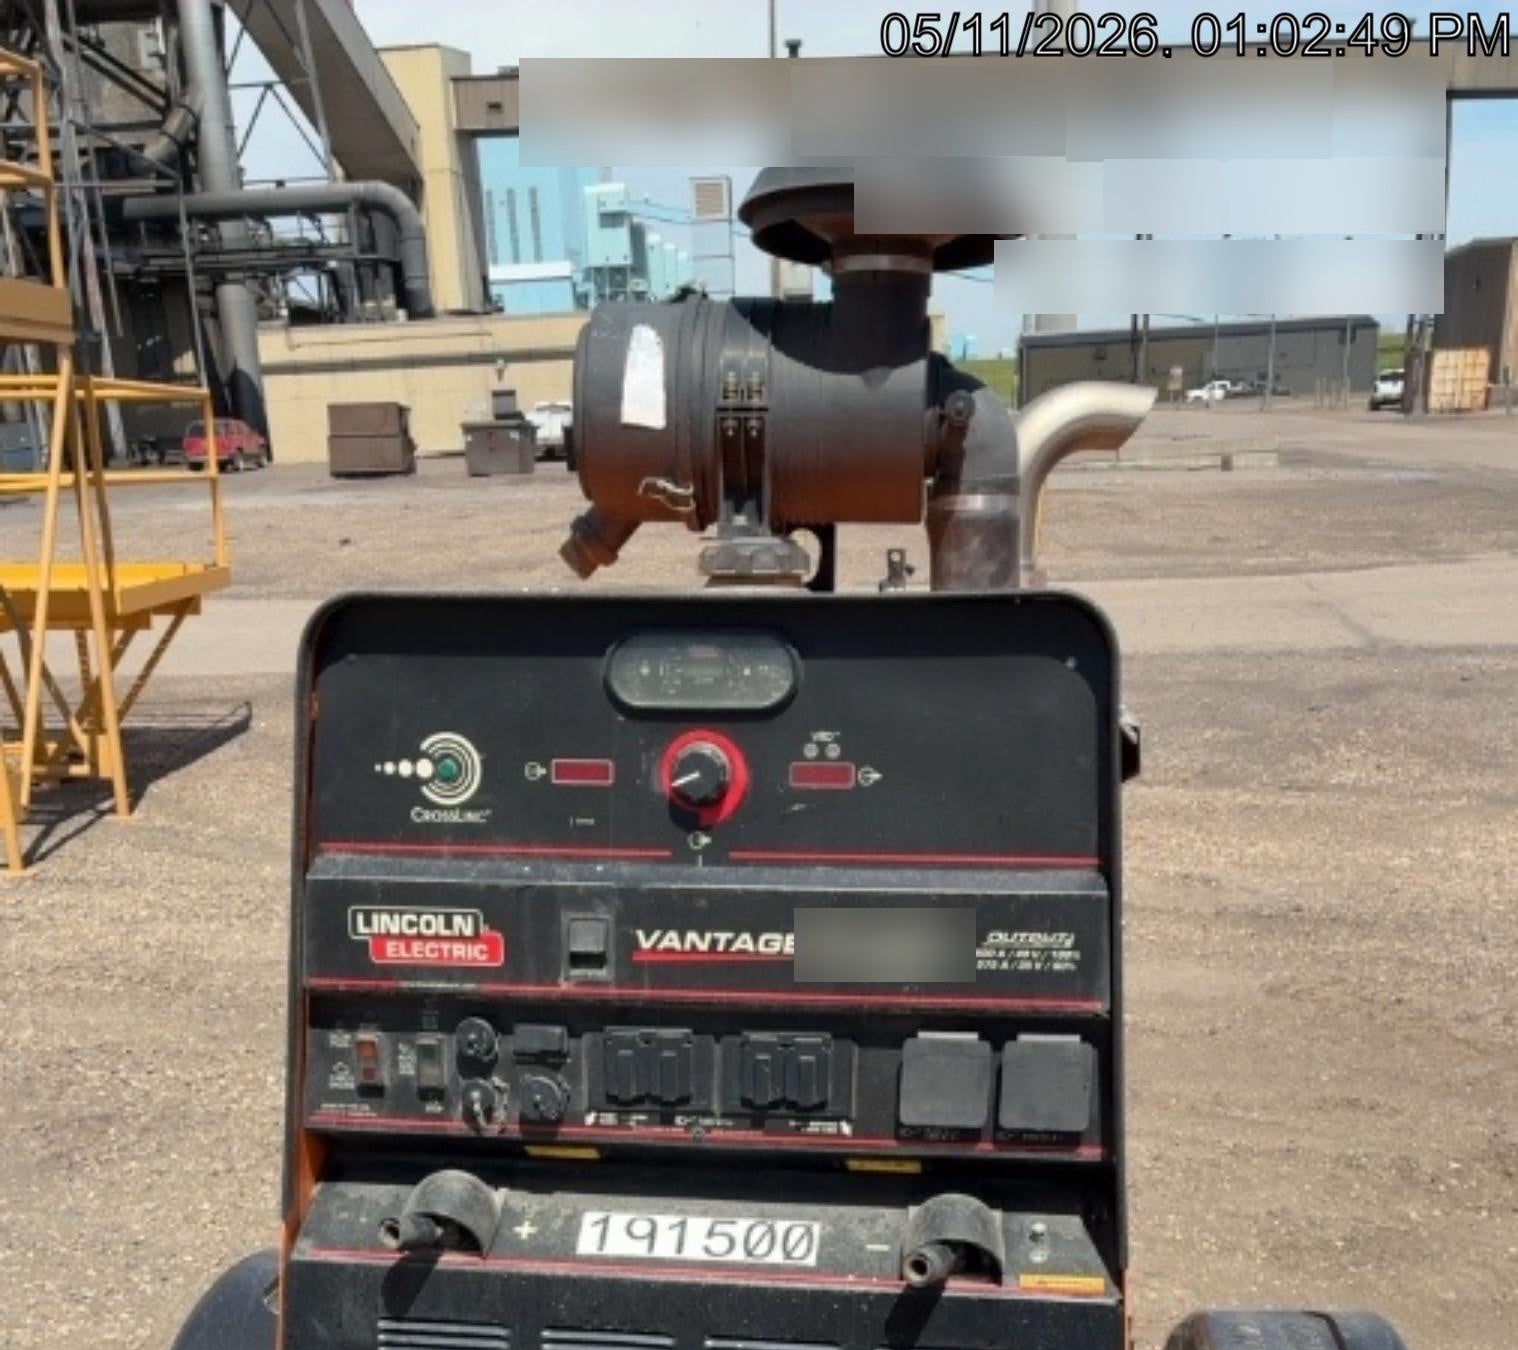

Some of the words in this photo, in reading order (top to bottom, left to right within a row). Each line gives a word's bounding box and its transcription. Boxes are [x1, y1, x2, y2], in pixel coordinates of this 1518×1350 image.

[356, 911, 474, 937] LINCOLN
[386, 940, 489, 961] ELECTRIC
[589, 1213, 815, 1261] 191500
